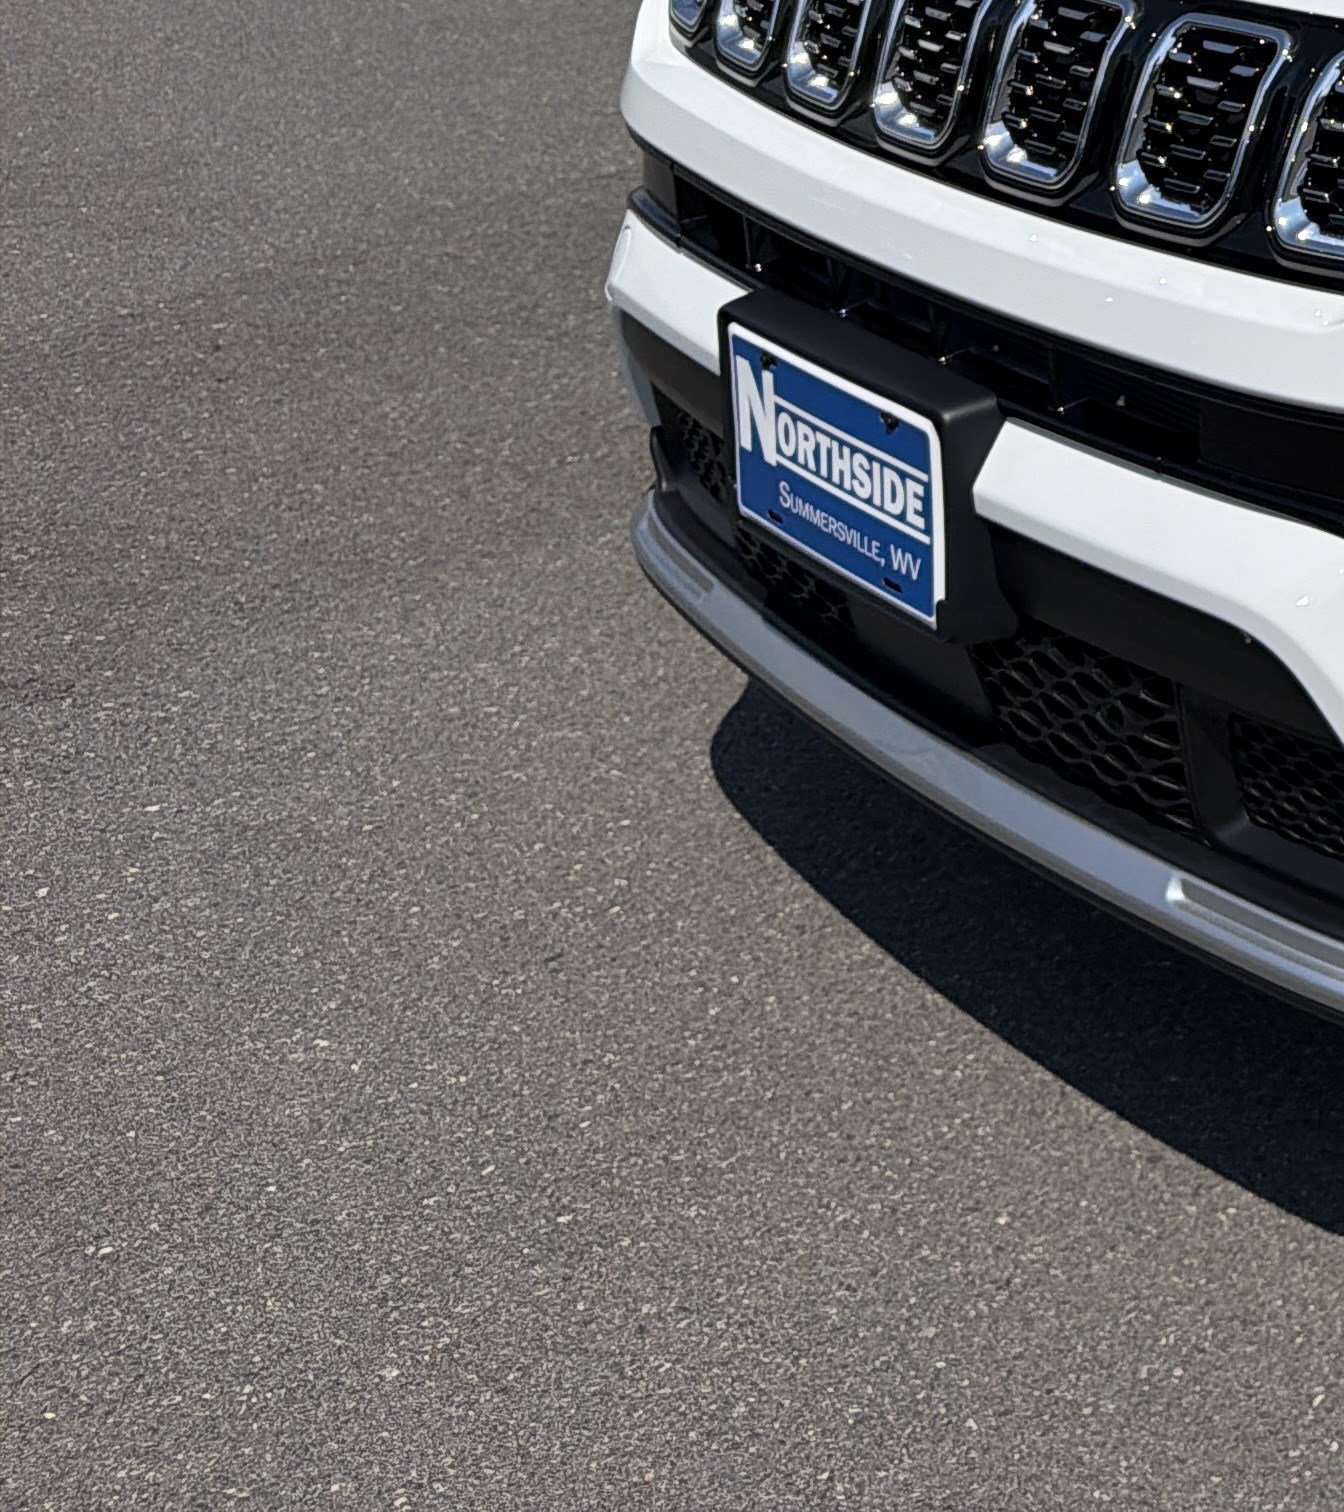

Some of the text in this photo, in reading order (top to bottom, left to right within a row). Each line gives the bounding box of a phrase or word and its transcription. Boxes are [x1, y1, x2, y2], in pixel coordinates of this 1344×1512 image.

[735, 354, 926, 530] NORTHSIDE
[778, 480, 921, 581] SUMMERSVILLE, WV
